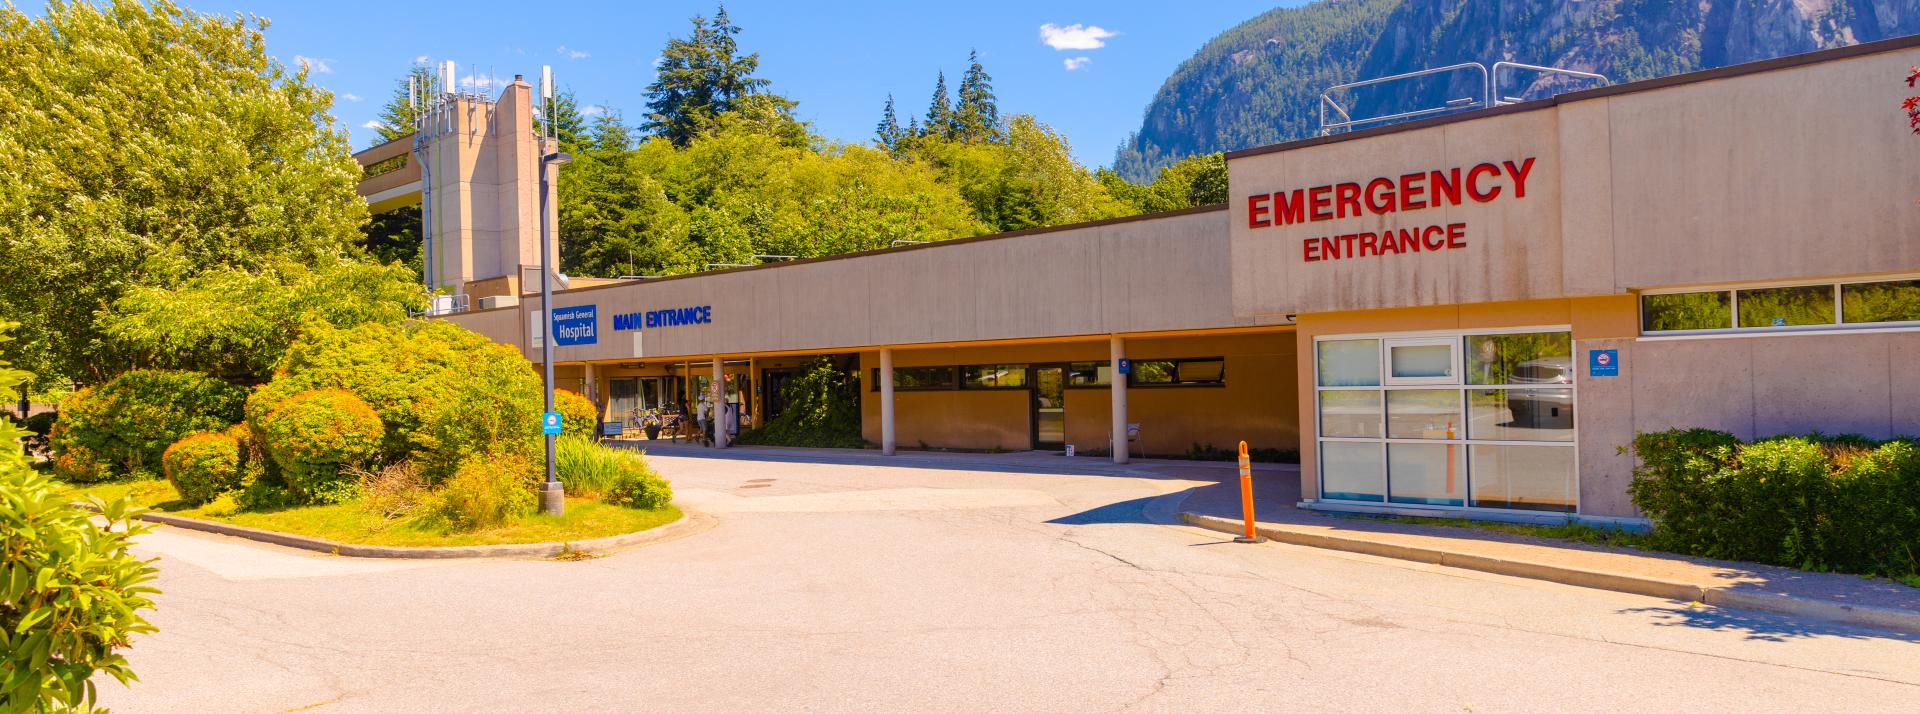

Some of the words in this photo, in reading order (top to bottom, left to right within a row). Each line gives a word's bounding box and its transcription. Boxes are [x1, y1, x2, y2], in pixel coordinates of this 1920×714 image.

[1248, 157, 1536, 229] EMERGENCY
[1303, 222, 1467, 262] ENTRANCE
[553, 312, 574, 322] Squamish
[575, 309, 594, 319] General
[613, 312, 642, 331] MAIN
[646, 305, 712, 328] ENTRANCE
[559, 322, 595, 342] Hospital
